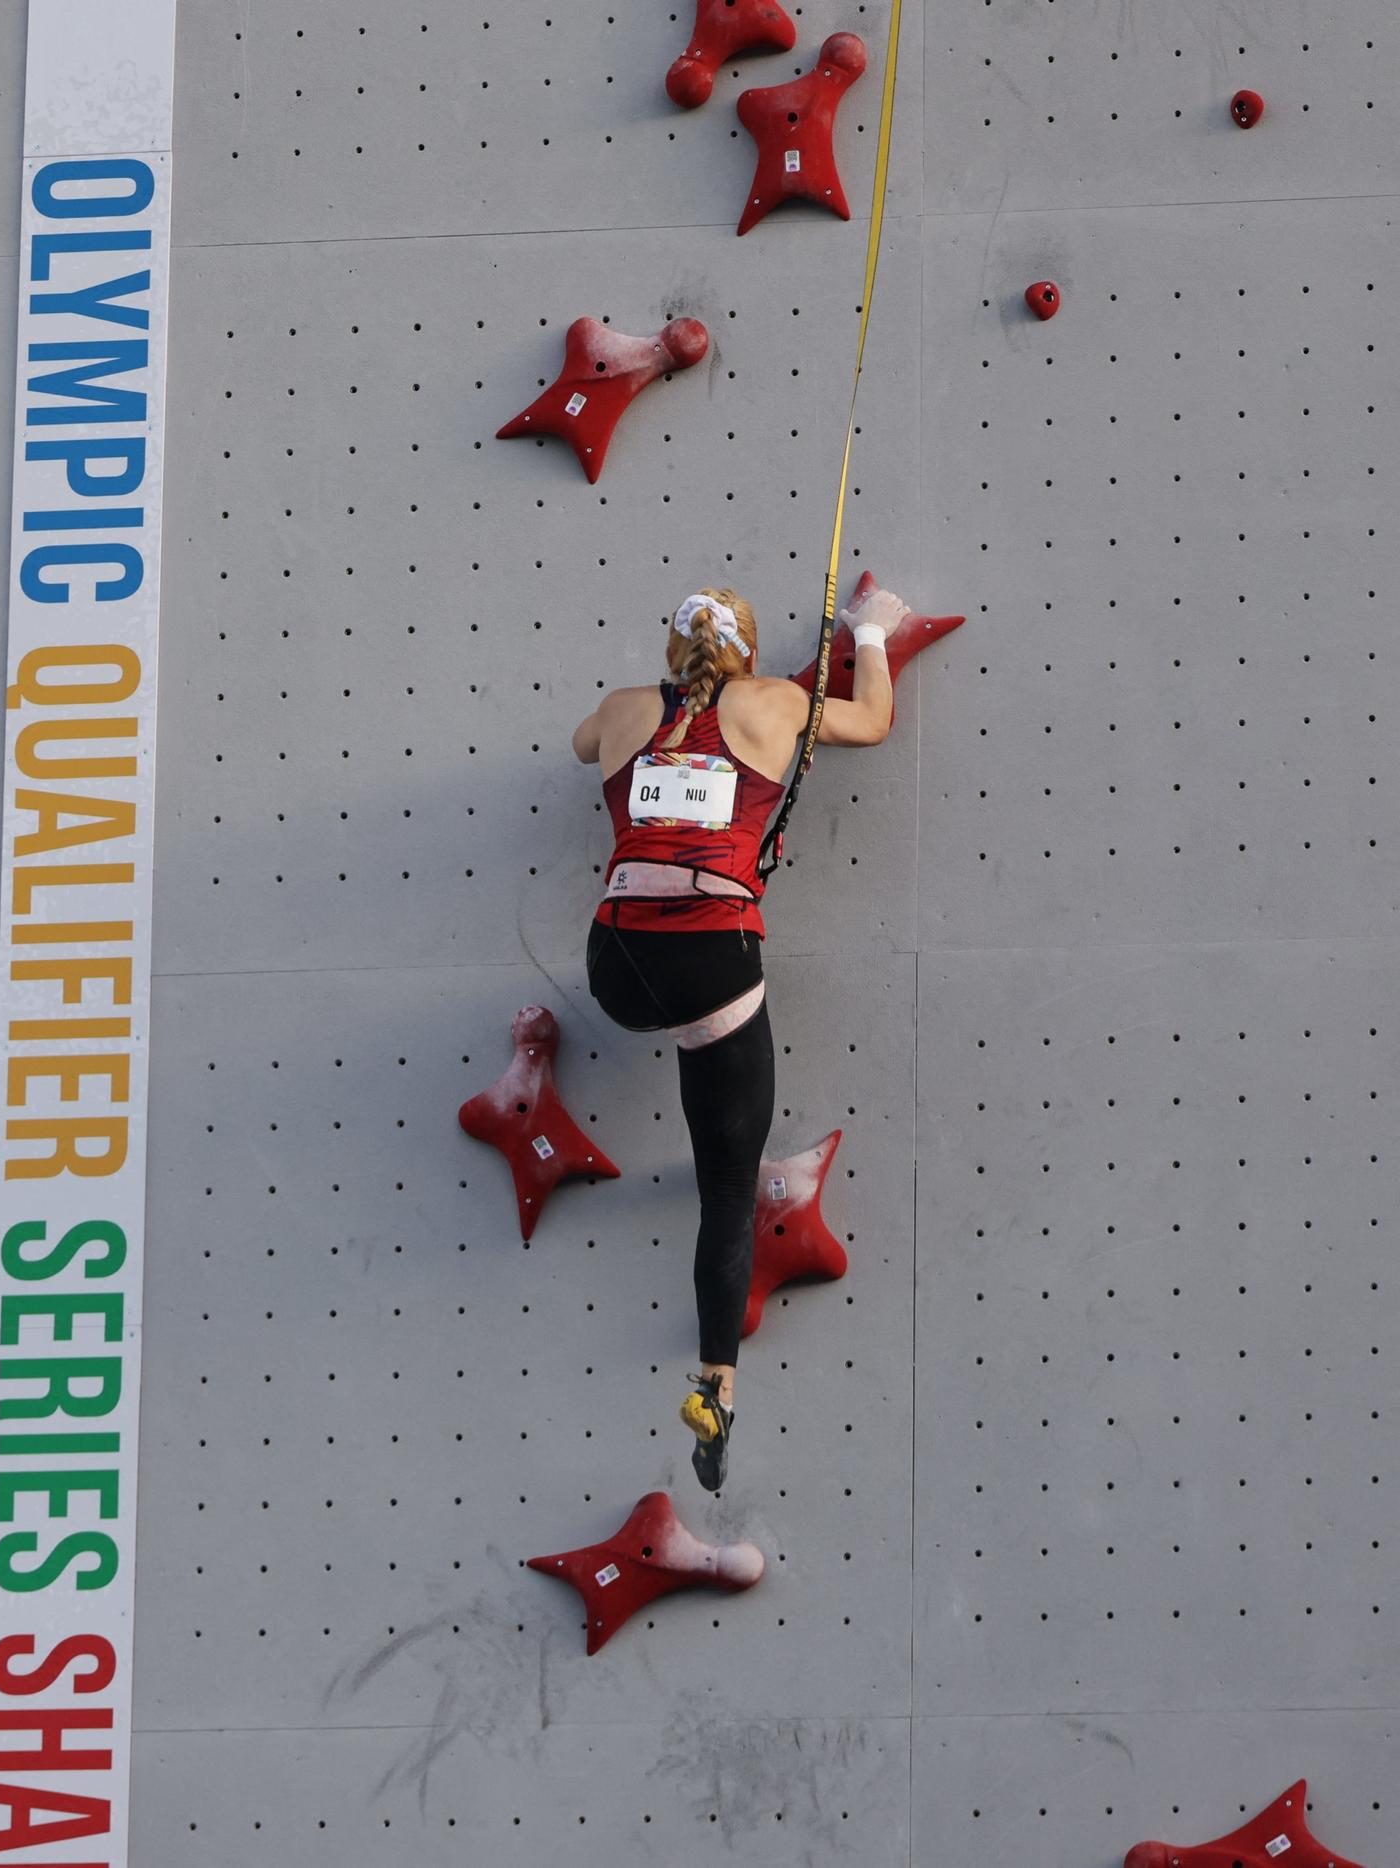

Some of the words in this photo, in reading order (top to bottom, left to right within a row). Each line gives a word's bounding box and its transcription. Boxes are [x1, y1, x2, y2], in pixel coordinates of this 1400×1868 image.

[20, 158, 155, 604] OLYMPIC
[817, 641, 831, 700] PERFECT
[803, 702, 823, 761] DESCENT
[640, 785, 661, 803] 04
[685, 788, 707, 802] NIU
[6, 645, 140, 1179] QUALIFIER
